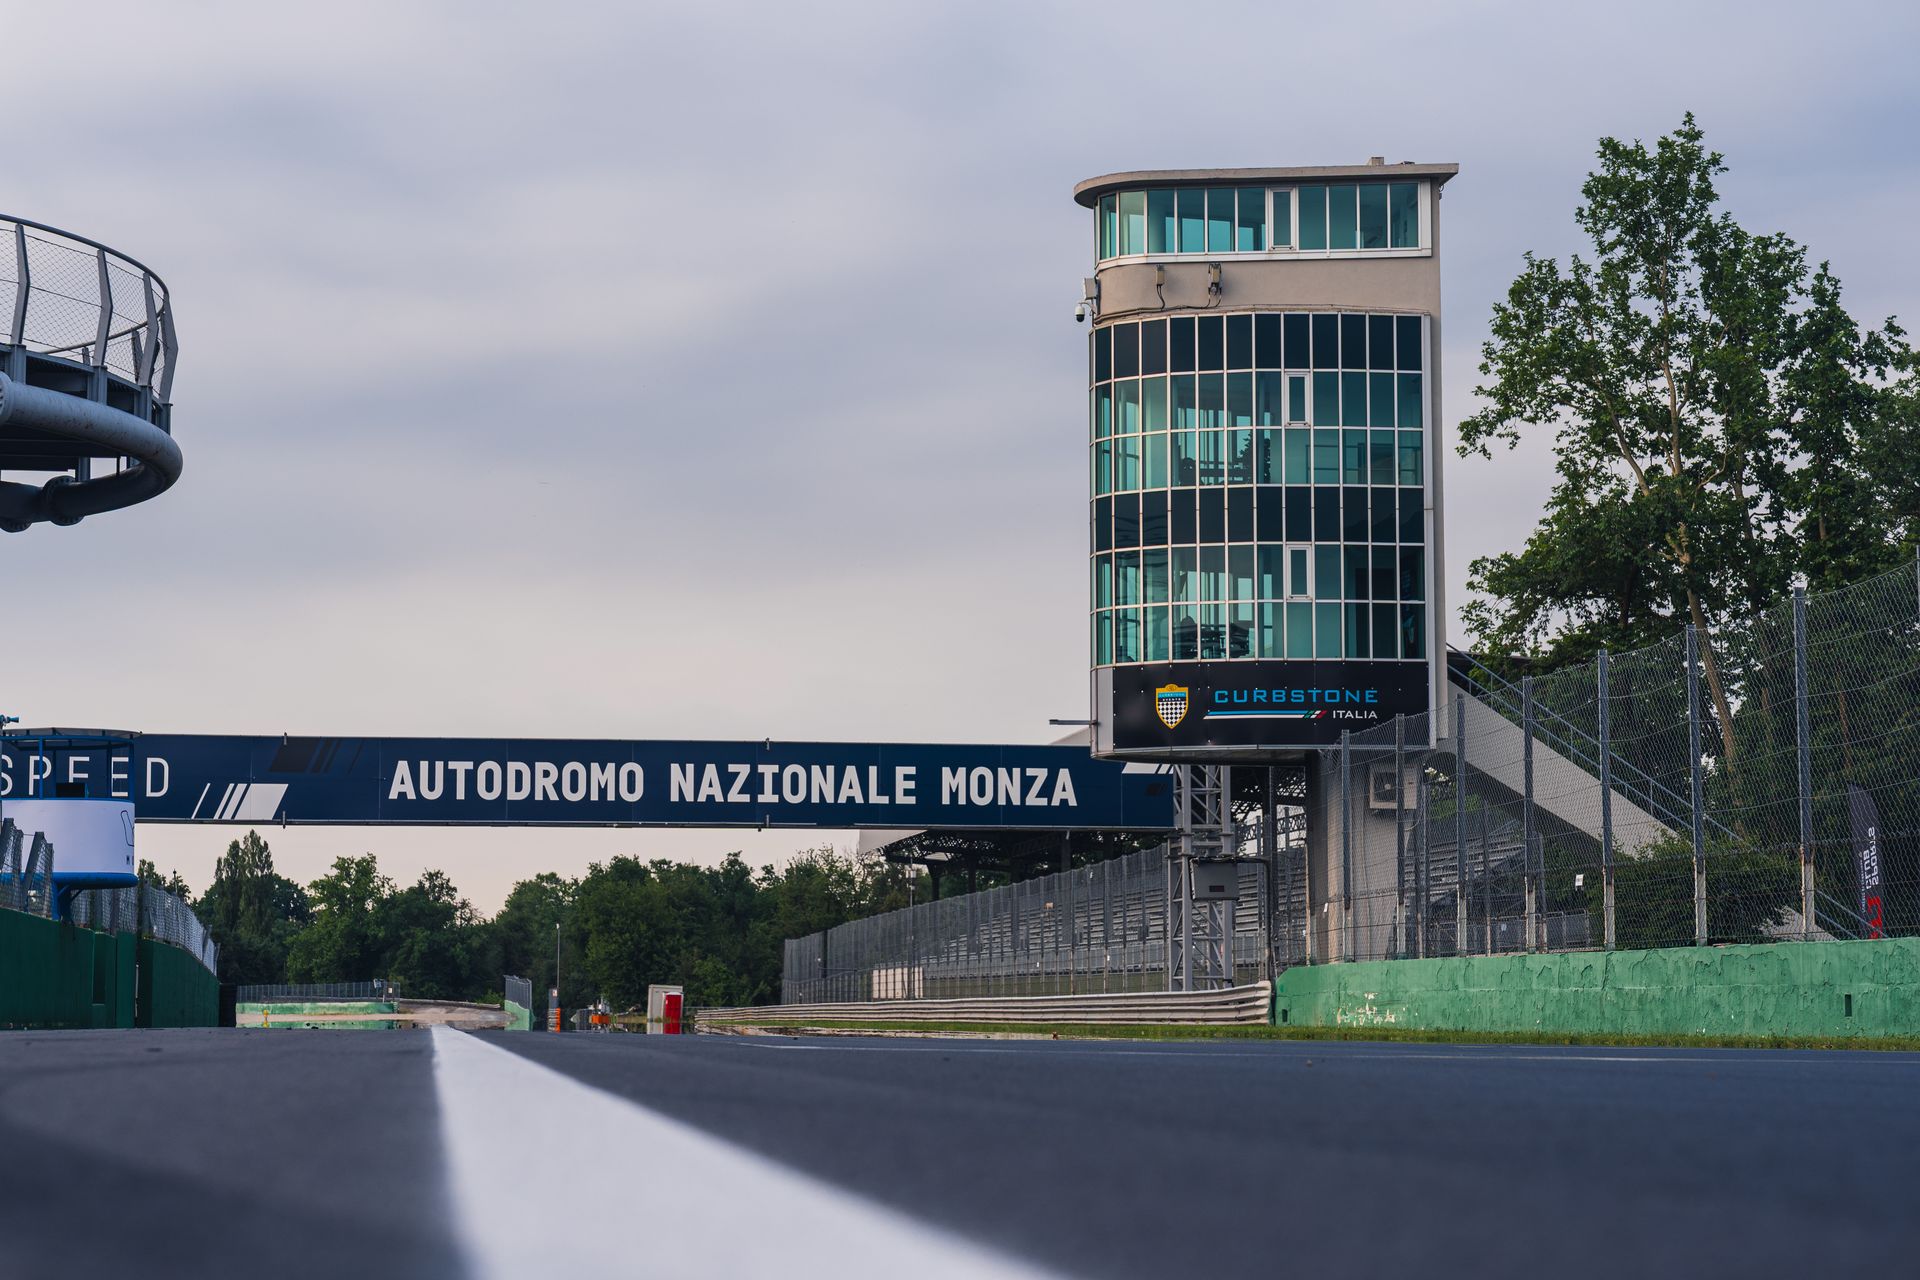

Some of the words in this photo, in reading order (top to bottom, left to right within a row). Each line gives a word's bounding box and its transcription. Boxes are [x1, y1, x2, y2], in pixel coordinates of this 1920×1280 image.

[1214, 689, 1378, 704] CURBSTONE
[1332, 709, 1378, 719] ITALIA
[388, 760, 644, 802] AUTODROMO
[670, 763, 917, 805] NAZIONALE
[941, 766, 1078, 807] MONZA
